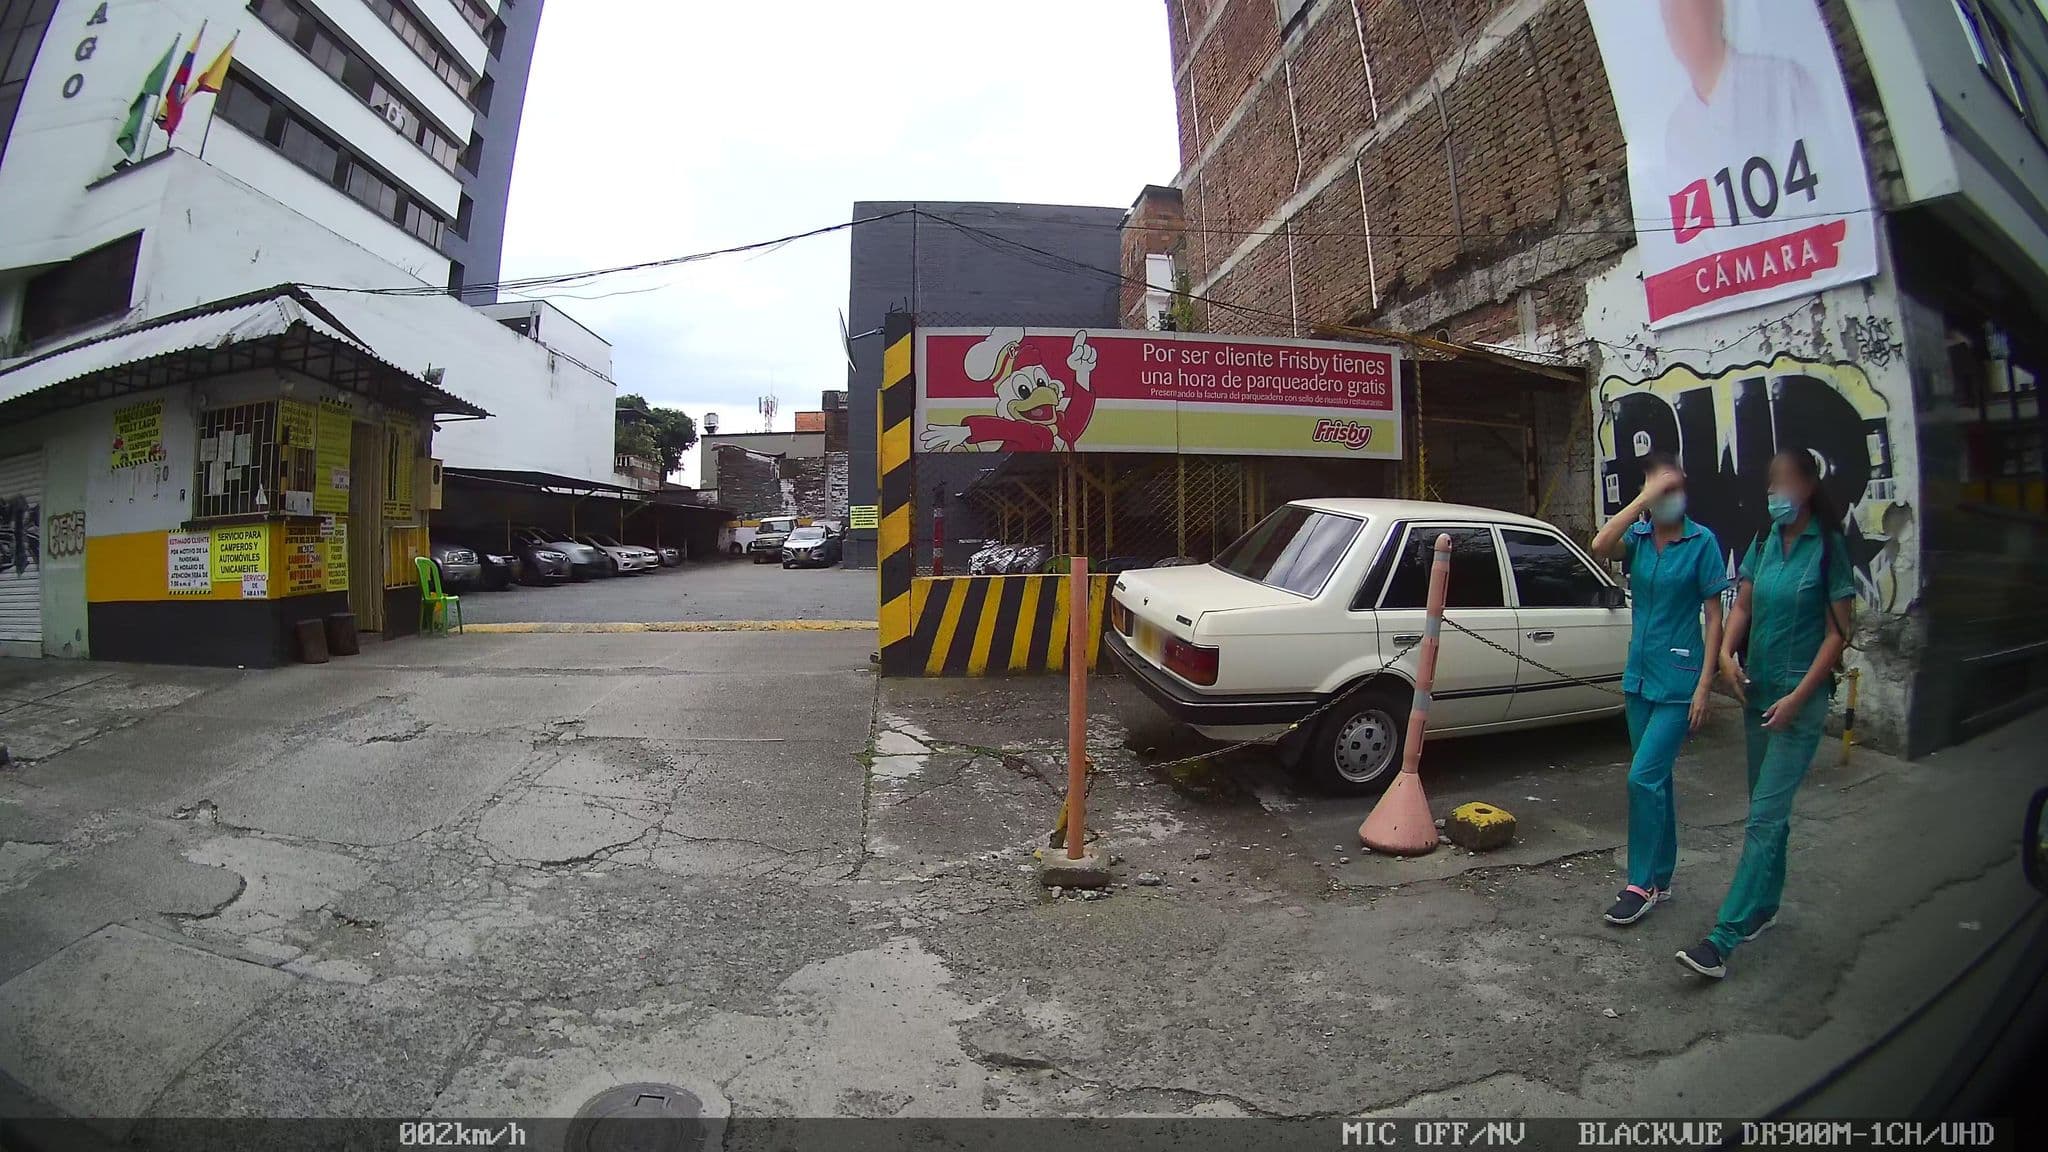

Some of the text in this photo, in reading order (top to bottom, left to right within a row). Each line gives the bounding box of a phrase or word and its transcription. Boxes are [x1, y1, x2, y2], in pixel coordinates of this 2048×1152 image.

[1714, 139, 1818, 226] 104
[1695, 238, 1818, 293] CÁMARA
[1143, 343, 1385, 376] Por ser cliente Frisby tienes
[1141, 368, 1386, 398] una hora de parqueadero gratis
[1150, 388, 1195, 399] Presentando
[1196, 389, 1203, 399] la
[1204, 389, 1228, 400] factura
[1229, 391, 1240, 400] del
[1241, 392, 1283, 403] parqueadero
[1298, 394, 1314, 403] sello
[1315, 395, 1324, 403] de
[1324, 396, 1348, 405] nuestro
[1349, 398, 1384, 406] restaurante
[1313, 419, 1372, 450] Frisby
[192, 536, 209, 544] CLIENTE
[217, 531, 261, 541] SERVICIO PARA
[220, 542, 258, 552] CAMPEROS Y
[218, 552, 260, 562] AUTOMÓVILES
[220, 565, 259, 573] UNICAMENTE
[243, 574, 267, 582] SERVICIO
